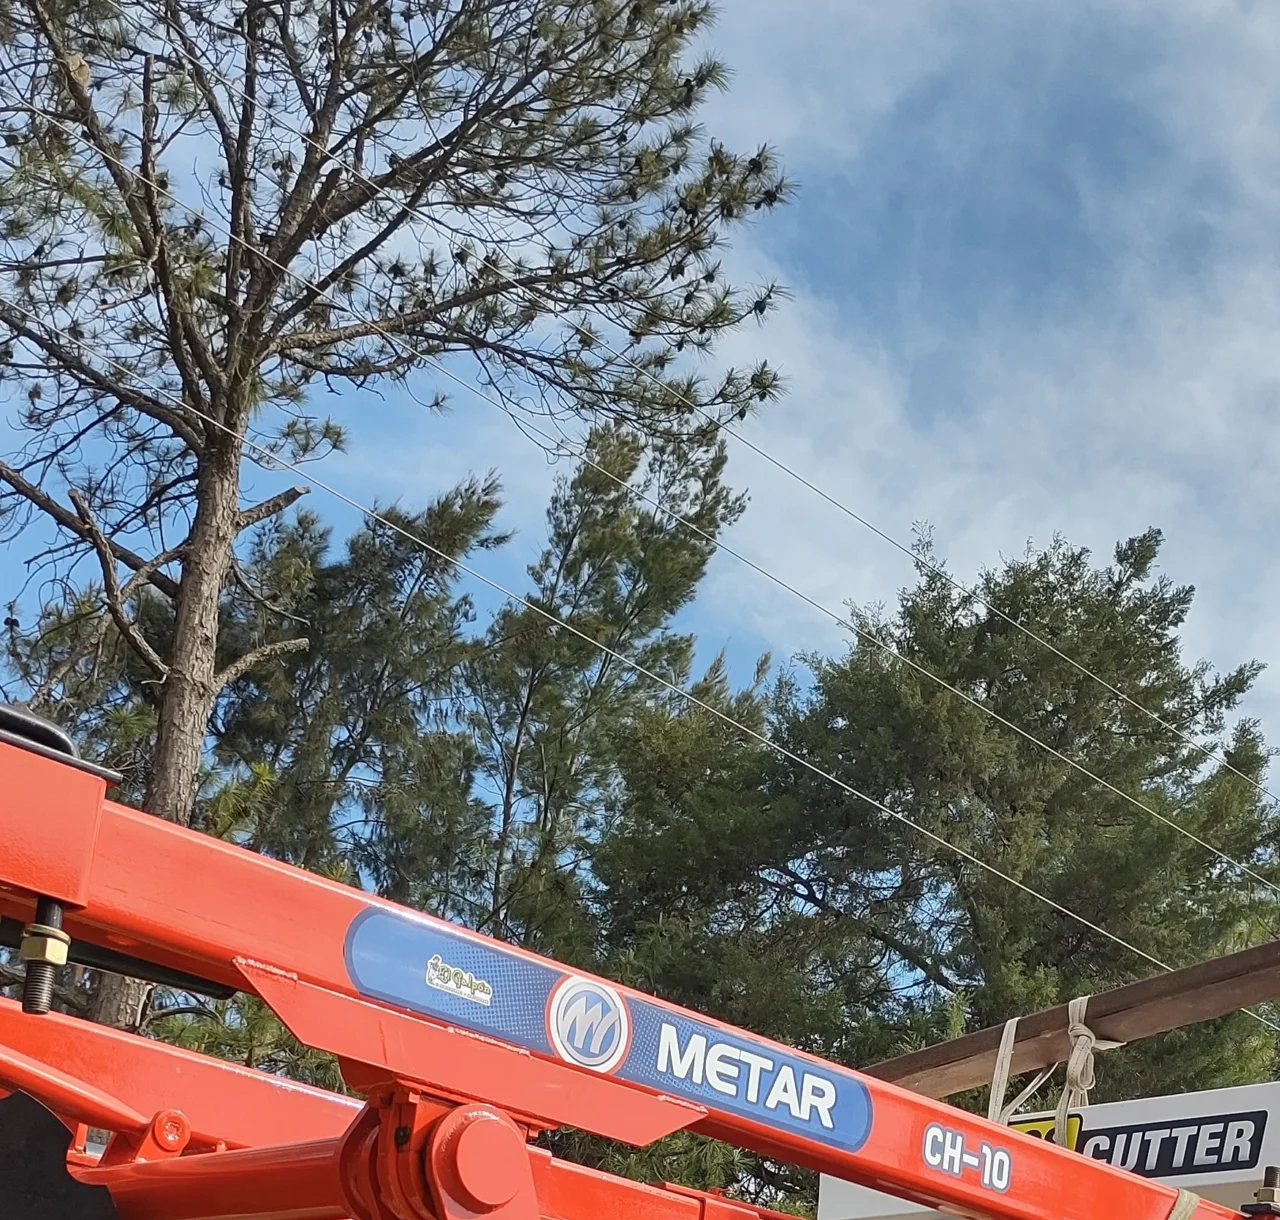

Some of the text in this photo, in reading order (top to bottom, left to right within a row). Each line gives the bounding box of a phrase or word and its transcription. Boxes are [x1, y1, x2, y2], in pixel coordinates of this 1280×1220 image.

[656, 1023, 836, 1129] METAR
[924, 1126, 1010, 1190] CH-10
[1084, 1120, 1256, 1171] CUTTER
